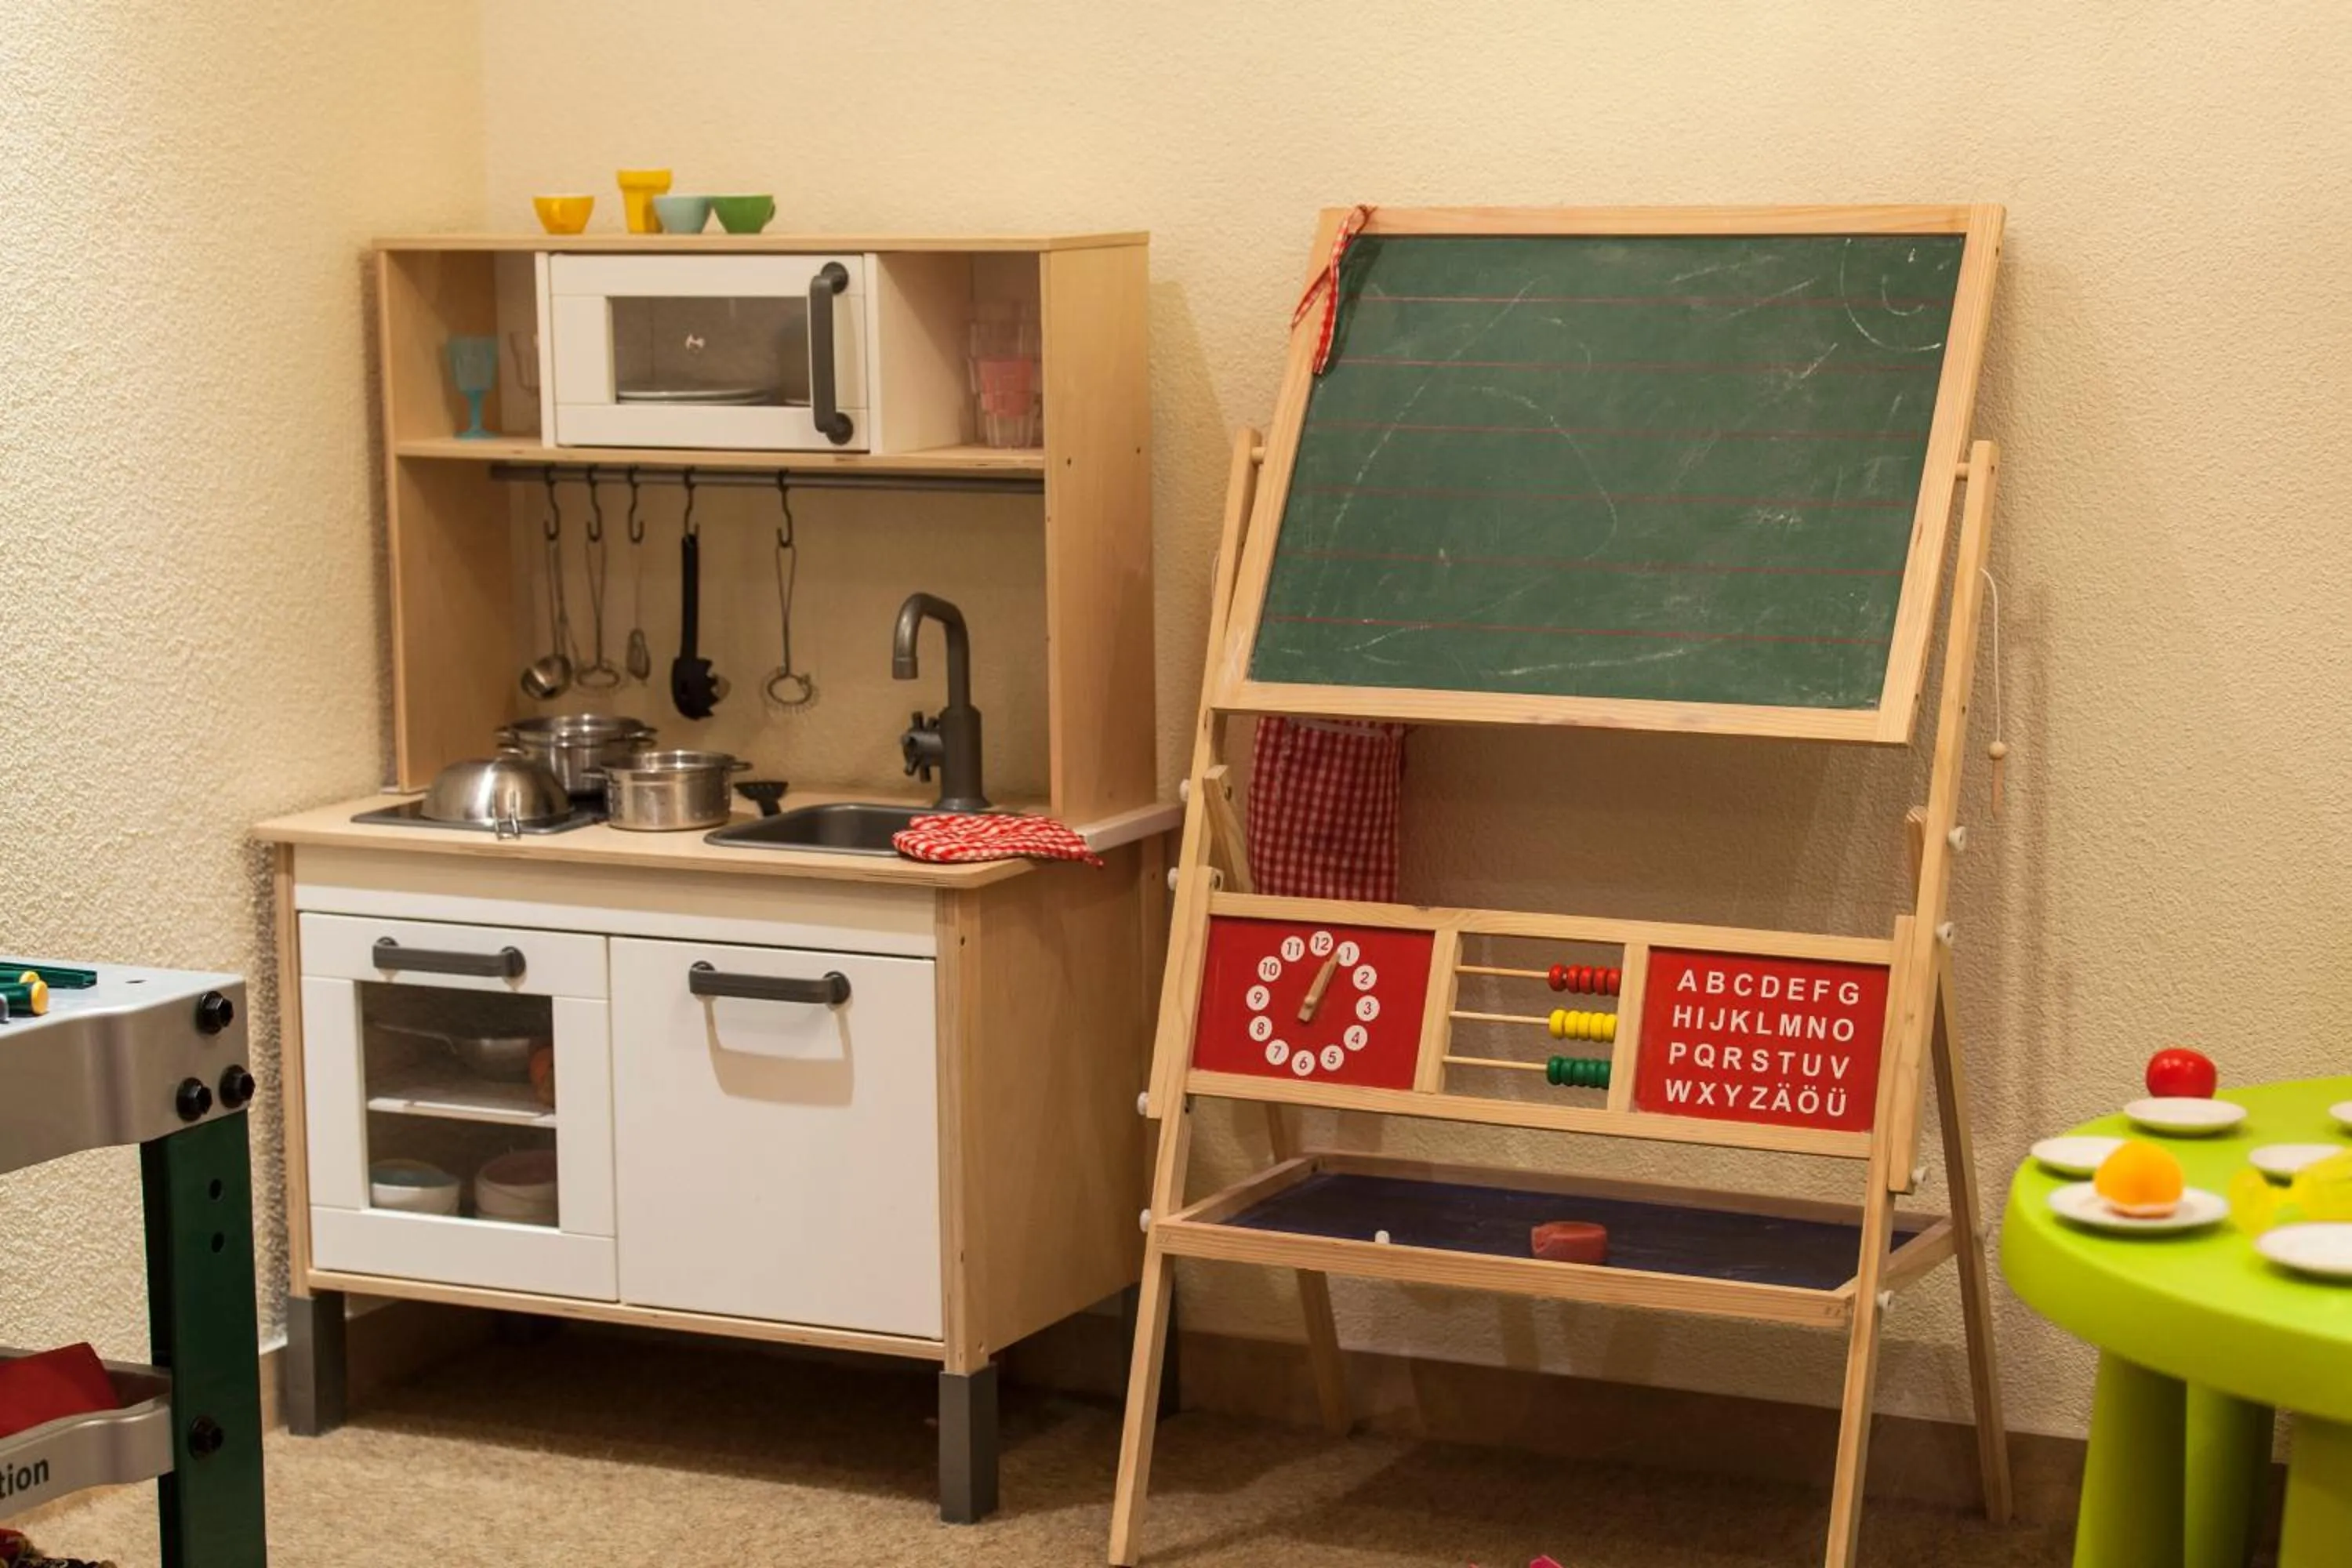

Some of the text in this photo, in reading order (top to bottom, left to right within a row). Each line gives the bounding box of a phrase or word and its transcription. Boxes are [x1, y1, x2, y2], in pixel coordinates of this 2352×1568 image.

[1286, 942, 1301, 956] 11
[1314, 936, 1330, 951] 12
[1345, 946, 1351, 960] 1
[1262, 961, 1278, 976] 10
[1360, 971, 1370, 985] 2
[1254, 990, 1263, 1004] 9
[1363, 1001, 1372, 1015] 3
[1256, 1022, 1265, 1036] 8
[1351, 1031, 1360, 1044] 4
[1273, 1045, 1282, 1059] 7
[1327, 1051, 1337, 1065] 5
[1298, 1056, 1308, 1070] 6
